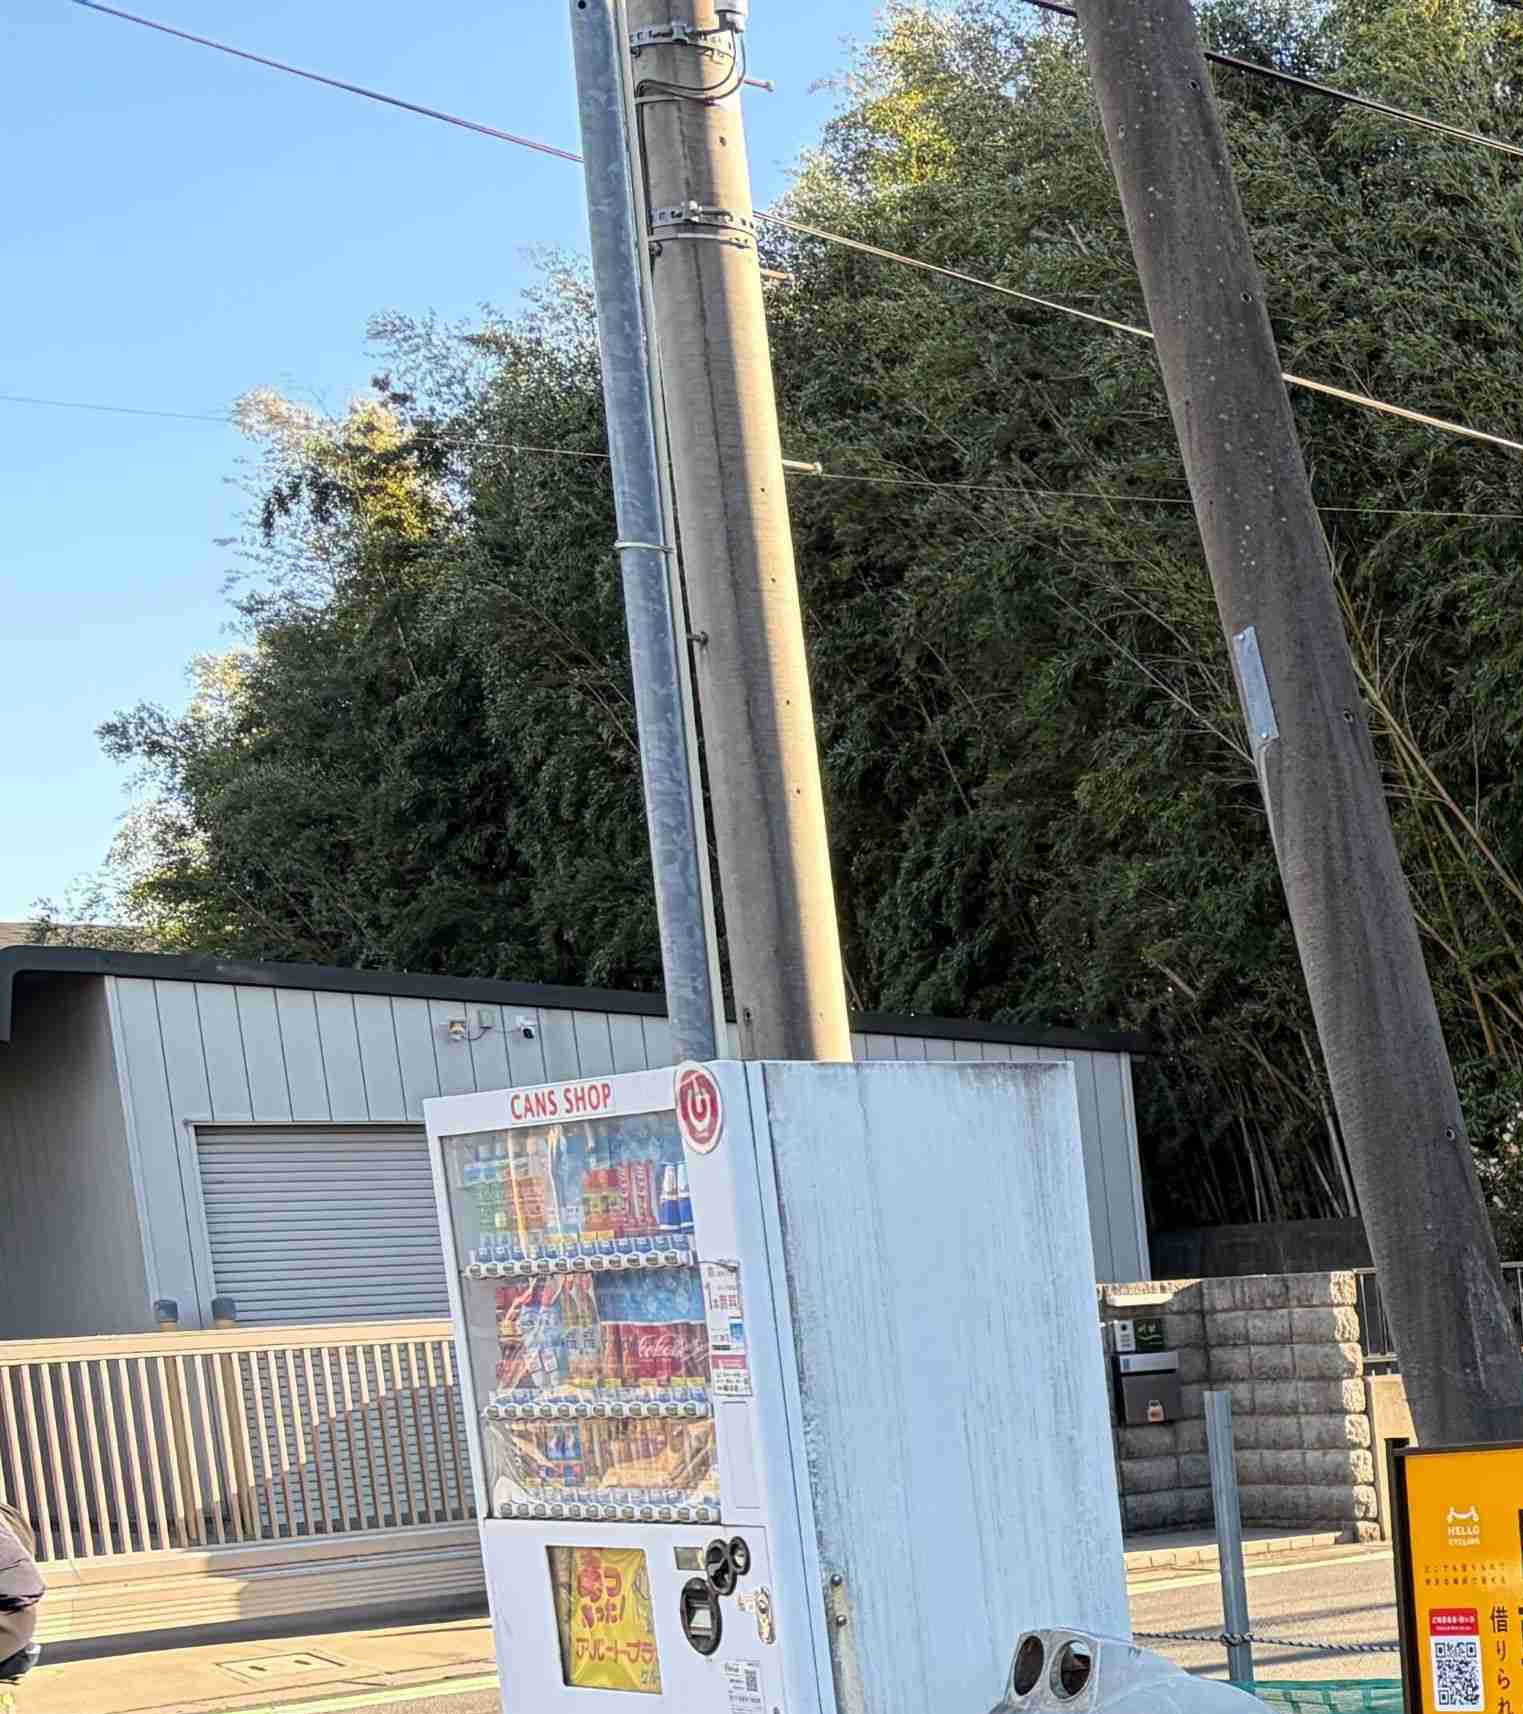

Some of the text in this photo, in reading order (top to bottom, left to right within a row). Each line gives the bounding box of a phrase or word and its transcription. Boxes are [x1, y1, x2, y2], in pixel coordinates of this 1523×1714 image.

[510, 1082, 612, 1121] CANS SHOP
[1447, 1525, 1480, 1537] HELLO
